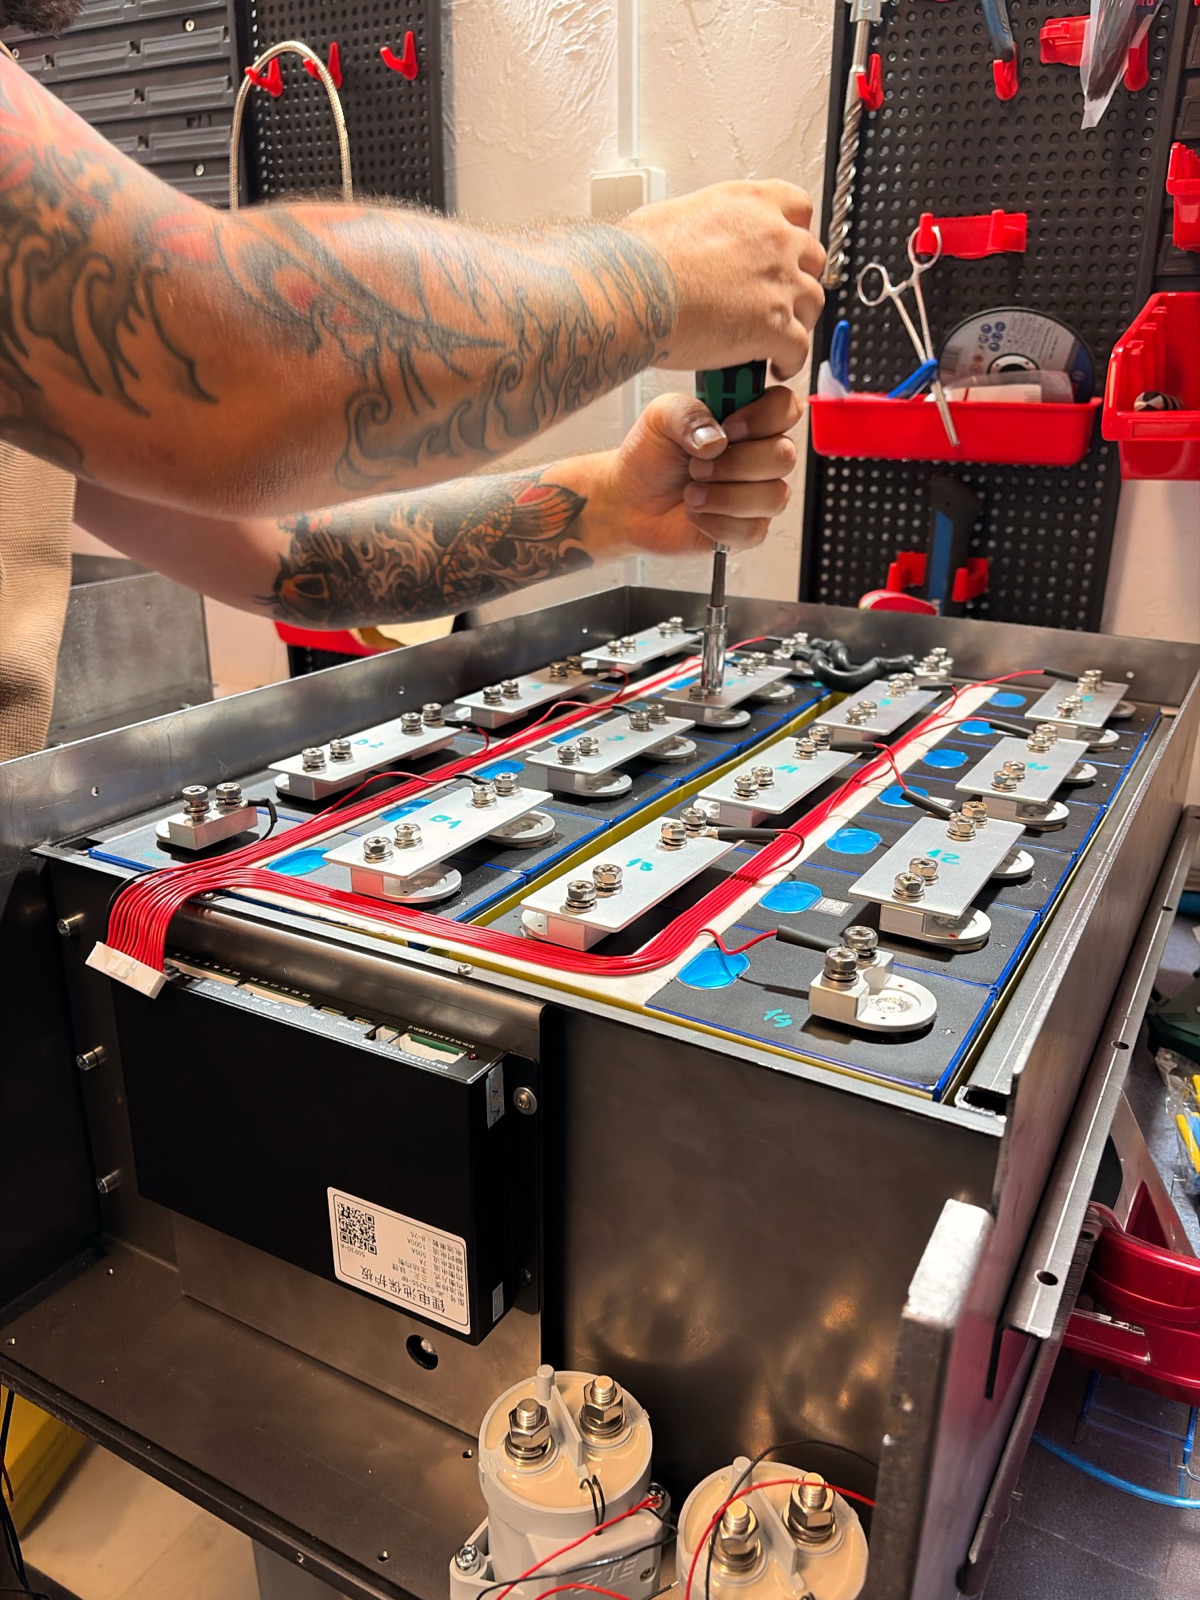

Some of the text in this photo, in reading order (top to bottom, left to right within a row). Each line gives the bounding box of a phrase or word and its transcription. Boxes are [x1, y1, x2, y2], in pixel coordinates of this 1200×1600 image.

[925, 848, 962, 866] 12
[360, 1265, 445, 1313] 锂电池保护板
